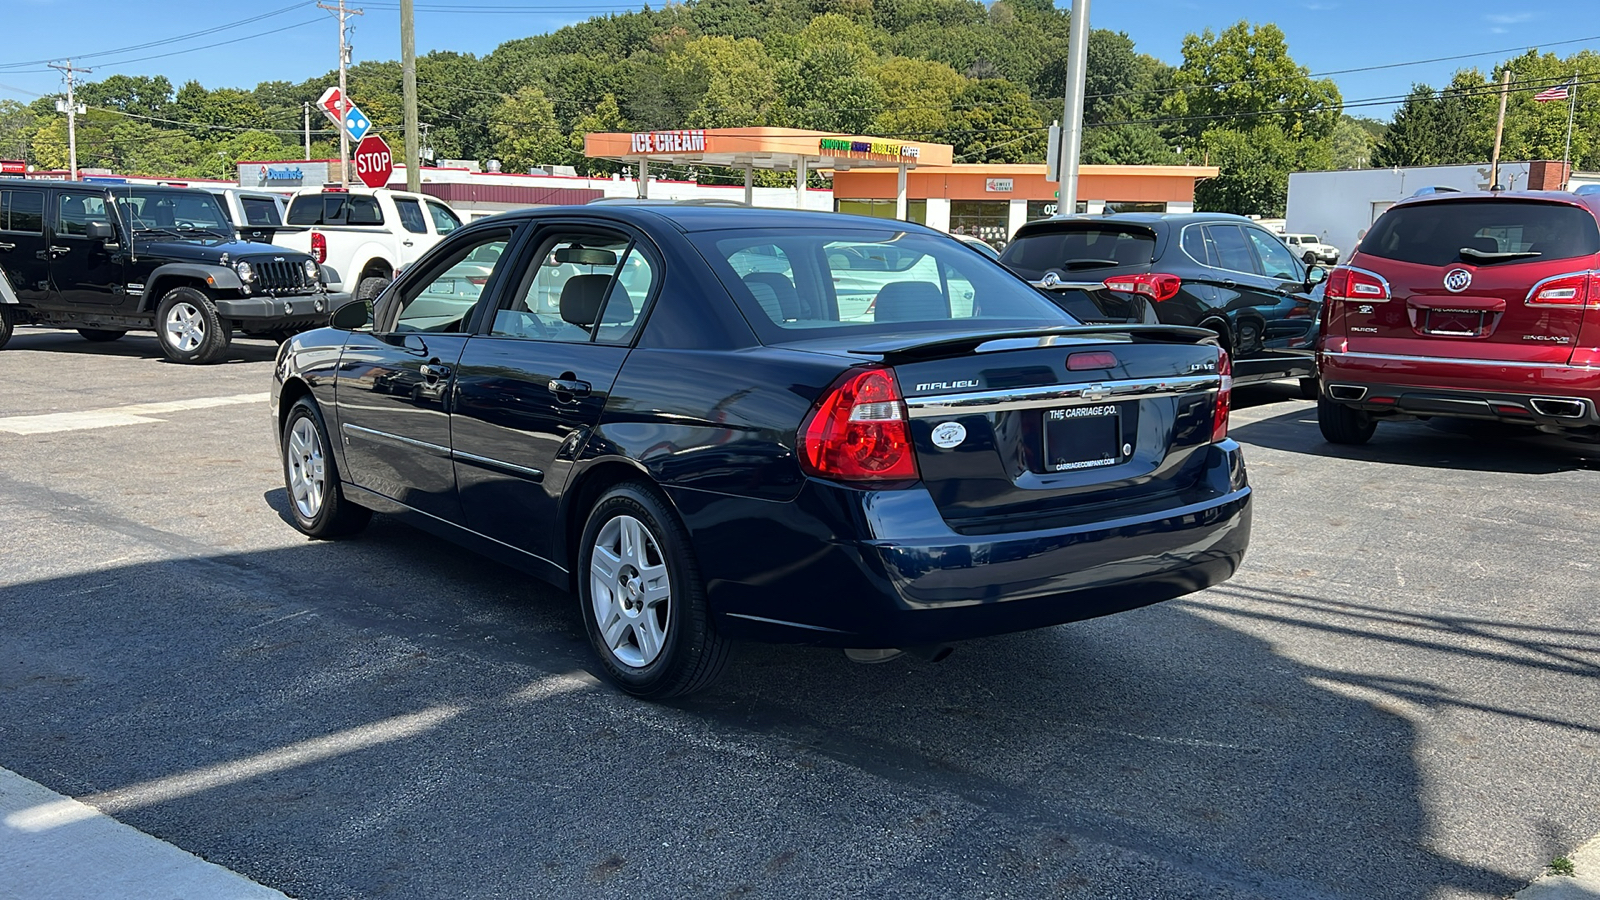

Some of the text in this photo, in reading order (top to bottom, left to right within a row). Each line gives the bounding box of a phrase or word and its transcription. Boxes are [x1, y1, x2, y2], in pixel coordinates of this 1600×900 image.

[631, 130, 706, 153] ICE CREAM
[358, 151, 389, 173] STOP
[267, 166, 304, 180] Domino's
[1044, 204, 1058, 215] OP
[915, 379, 979, 391] MALIBU
[1050, 405, 1117, 420] THE CARRIAGE CO.
[1056, 458, 1115, 471] CARRIAGECOMPANY.COM
